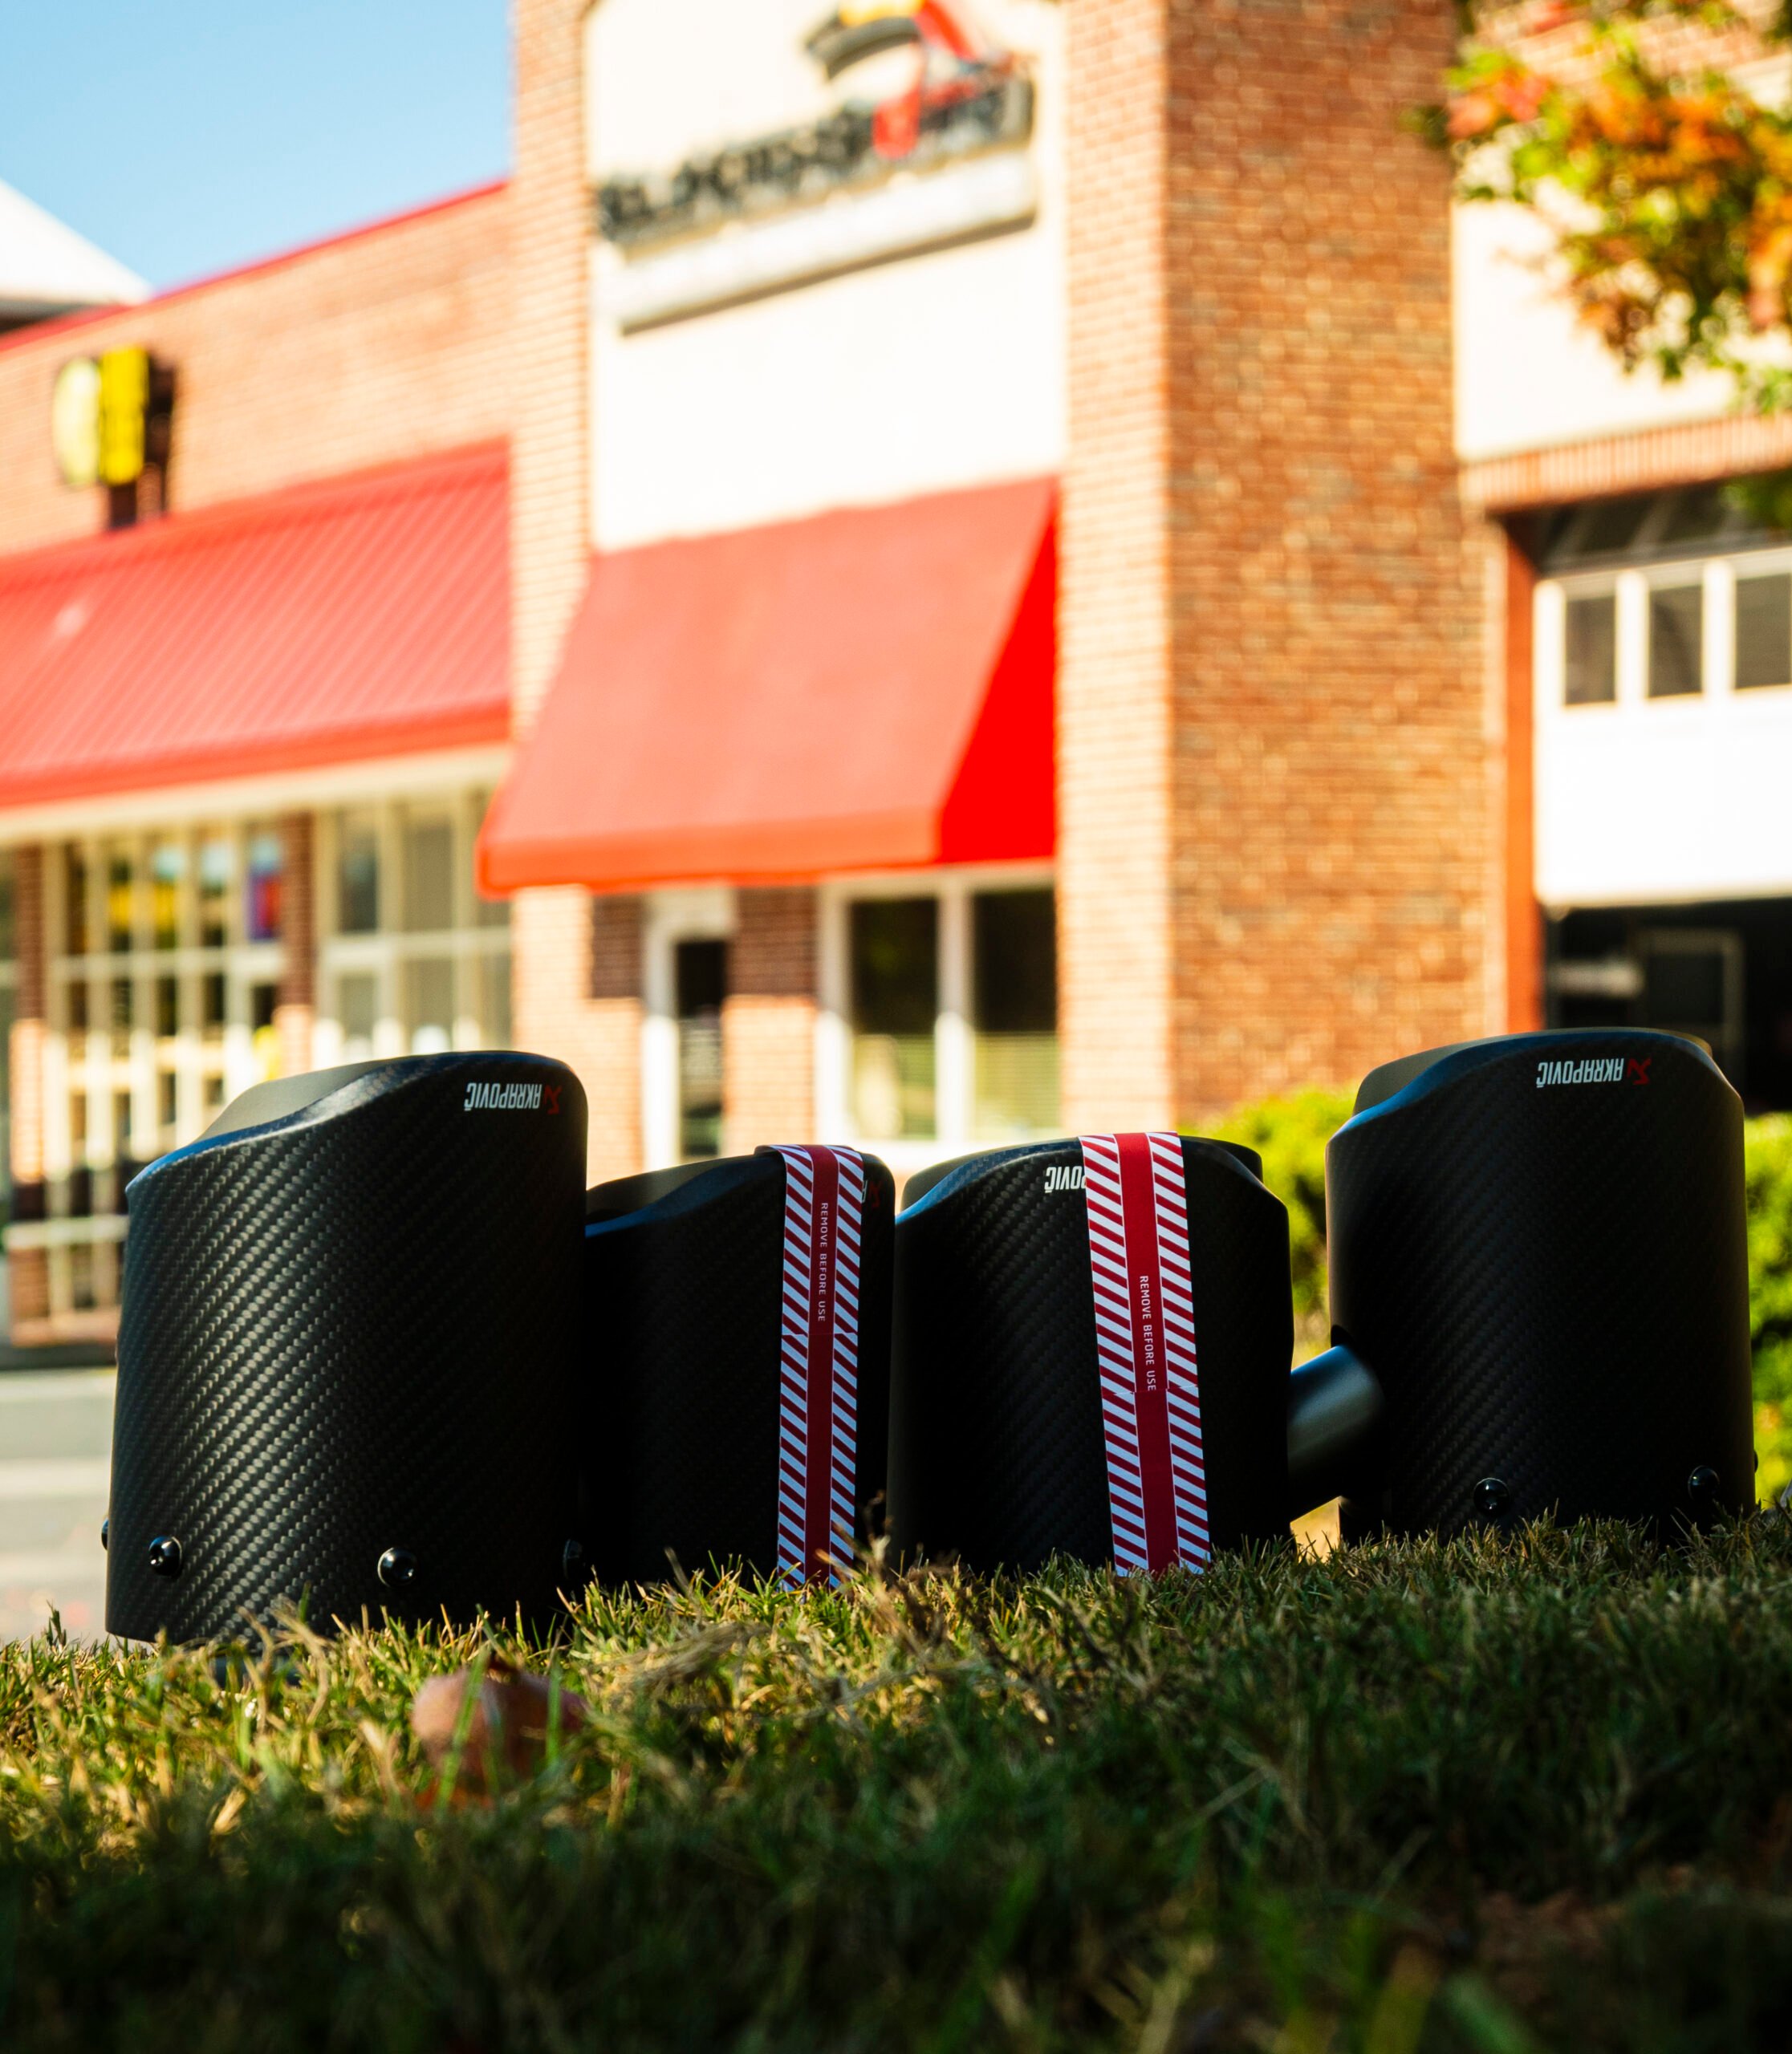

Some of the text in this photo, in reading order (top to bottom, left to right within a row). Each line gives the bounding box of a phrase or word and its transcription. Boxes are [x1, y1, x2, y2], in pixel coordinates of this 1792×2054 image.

[817, 1203, 829, 1321] REMOVE BEFORE USE
[1139, 1275, 1156, 1391] REMOVE BEFORE USE
